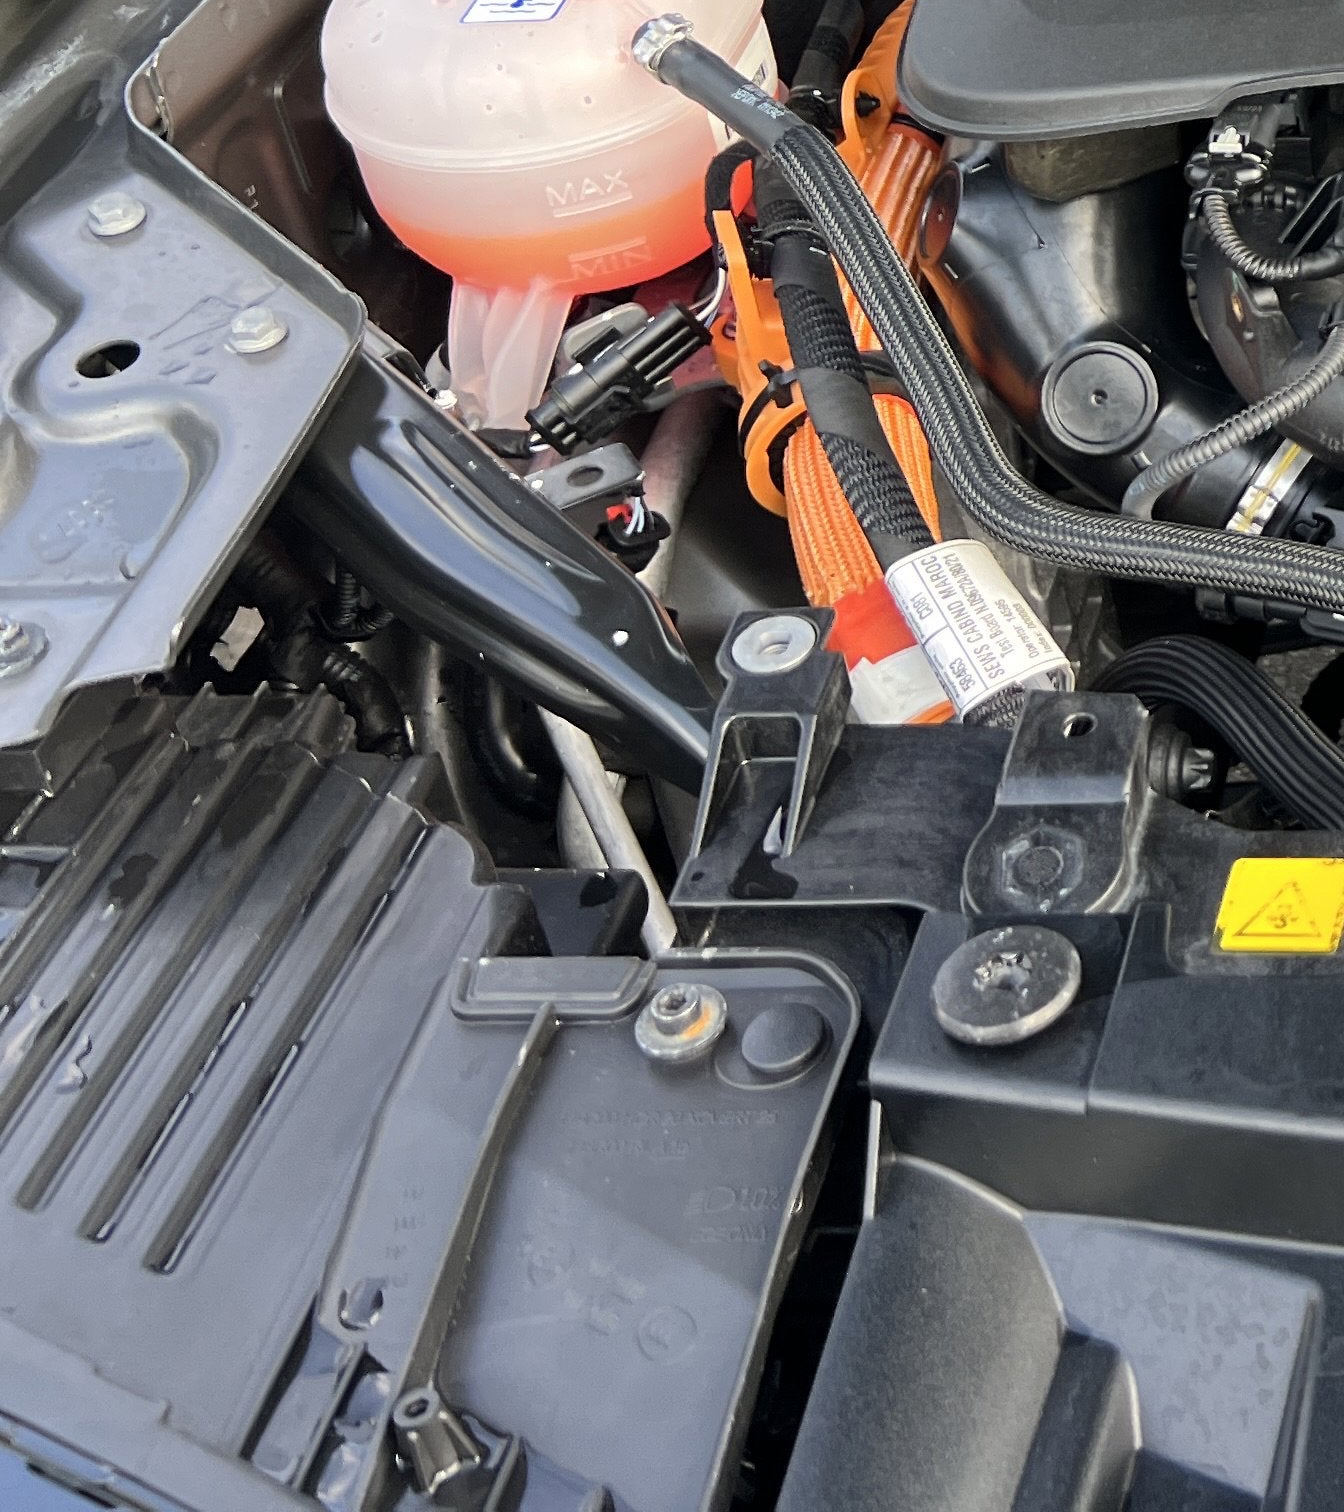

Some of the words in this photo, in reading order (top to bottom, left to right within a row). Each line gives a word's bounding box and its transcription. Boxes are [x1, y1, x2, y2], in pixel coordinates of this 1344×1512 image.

[545, 170, 629, 206] MAX
[571, 244, 651, 279] MIN
[921, 555, 957, 600] MAROC
[947, 600, 983, 644] CABIND
[981, 613, 1003, 639] Board
[973, 643, 1005, 679] SEWS
[998, 639, 1014, 658] Test
[949, 657, 976, 692] 58463
